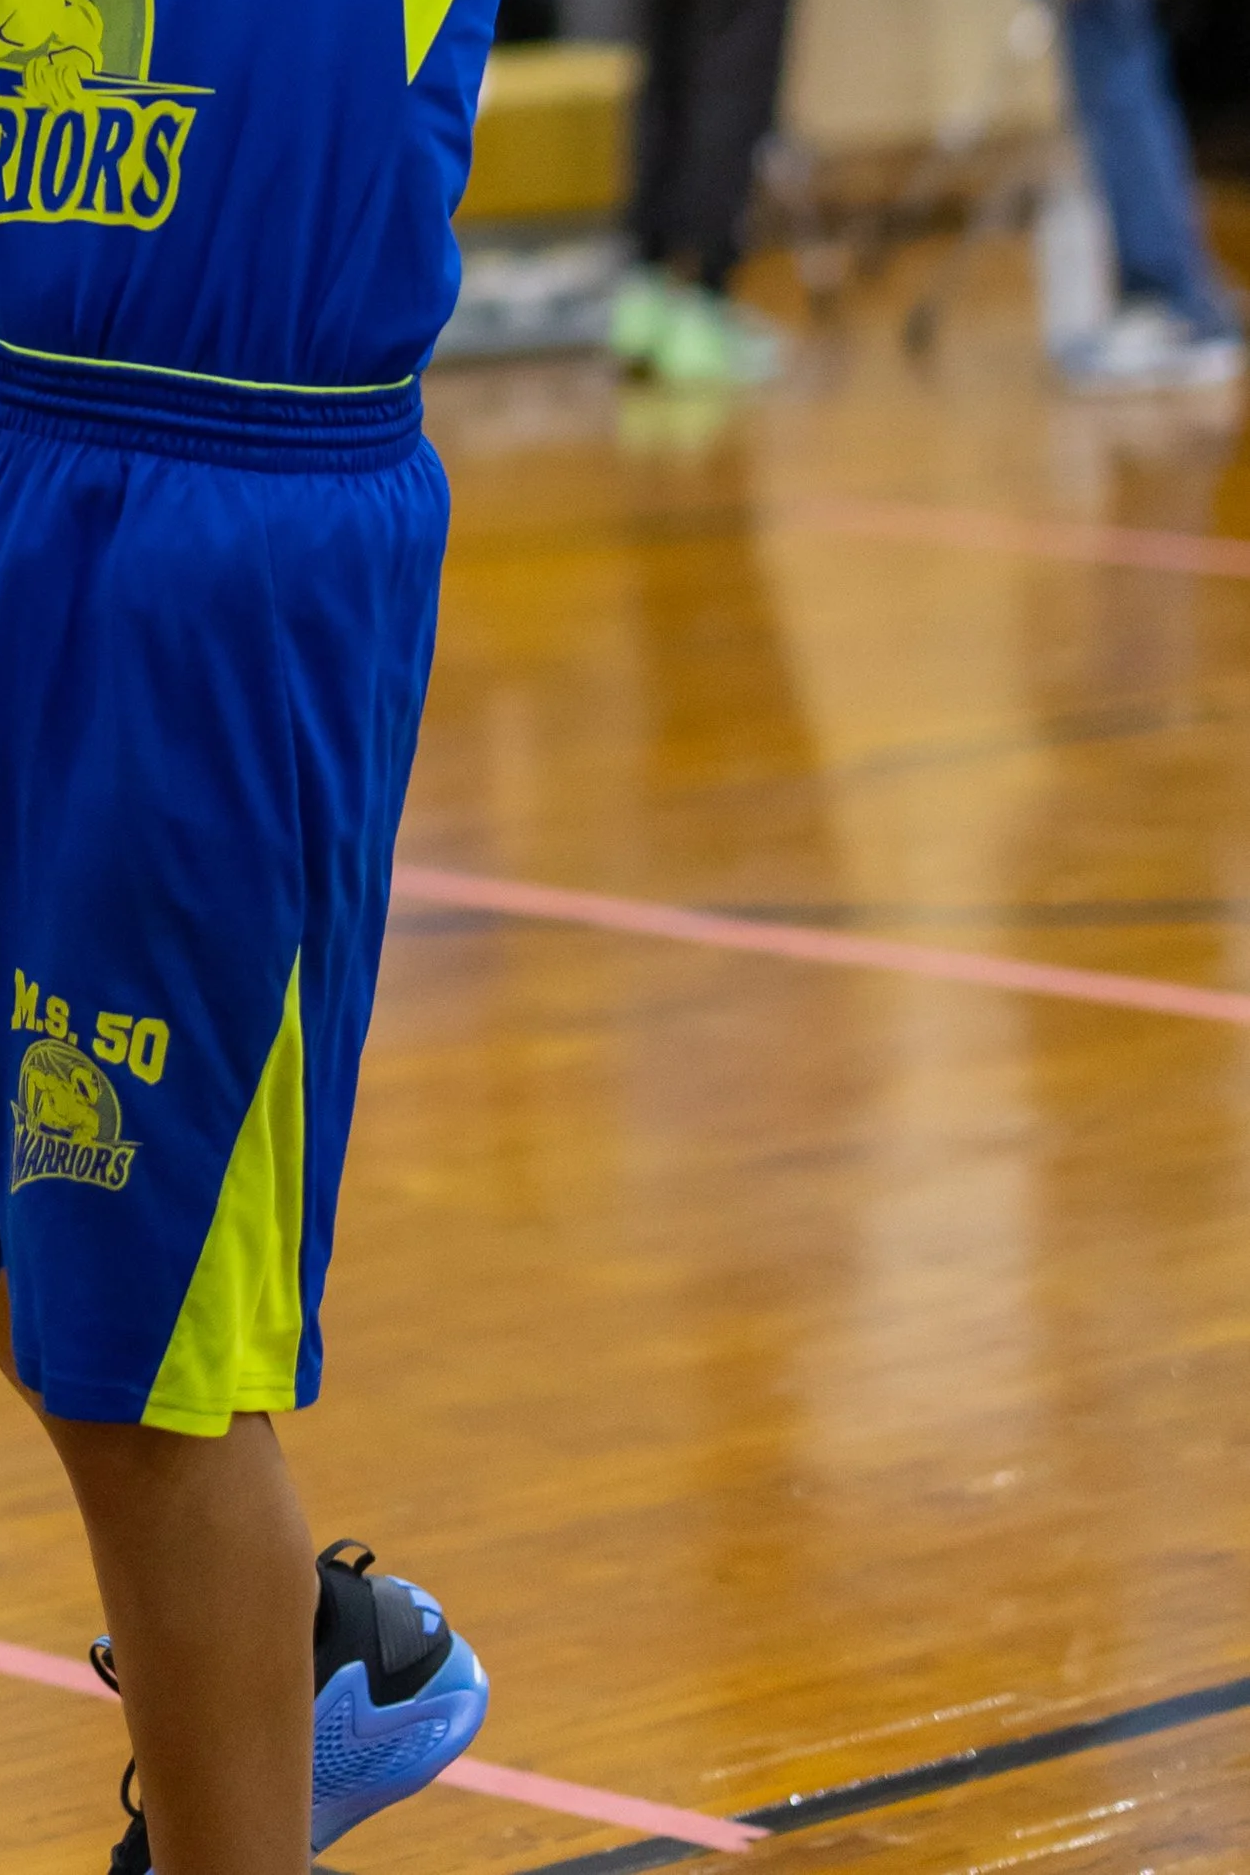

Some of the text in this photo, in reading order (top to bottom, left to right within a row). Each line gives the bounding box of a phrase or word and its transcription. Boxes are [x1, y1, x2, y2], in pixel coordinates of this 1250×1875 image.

[11, 967, 170, 1086] M.S. 50
[11, 1124, 136, 1194] WARRIORS
